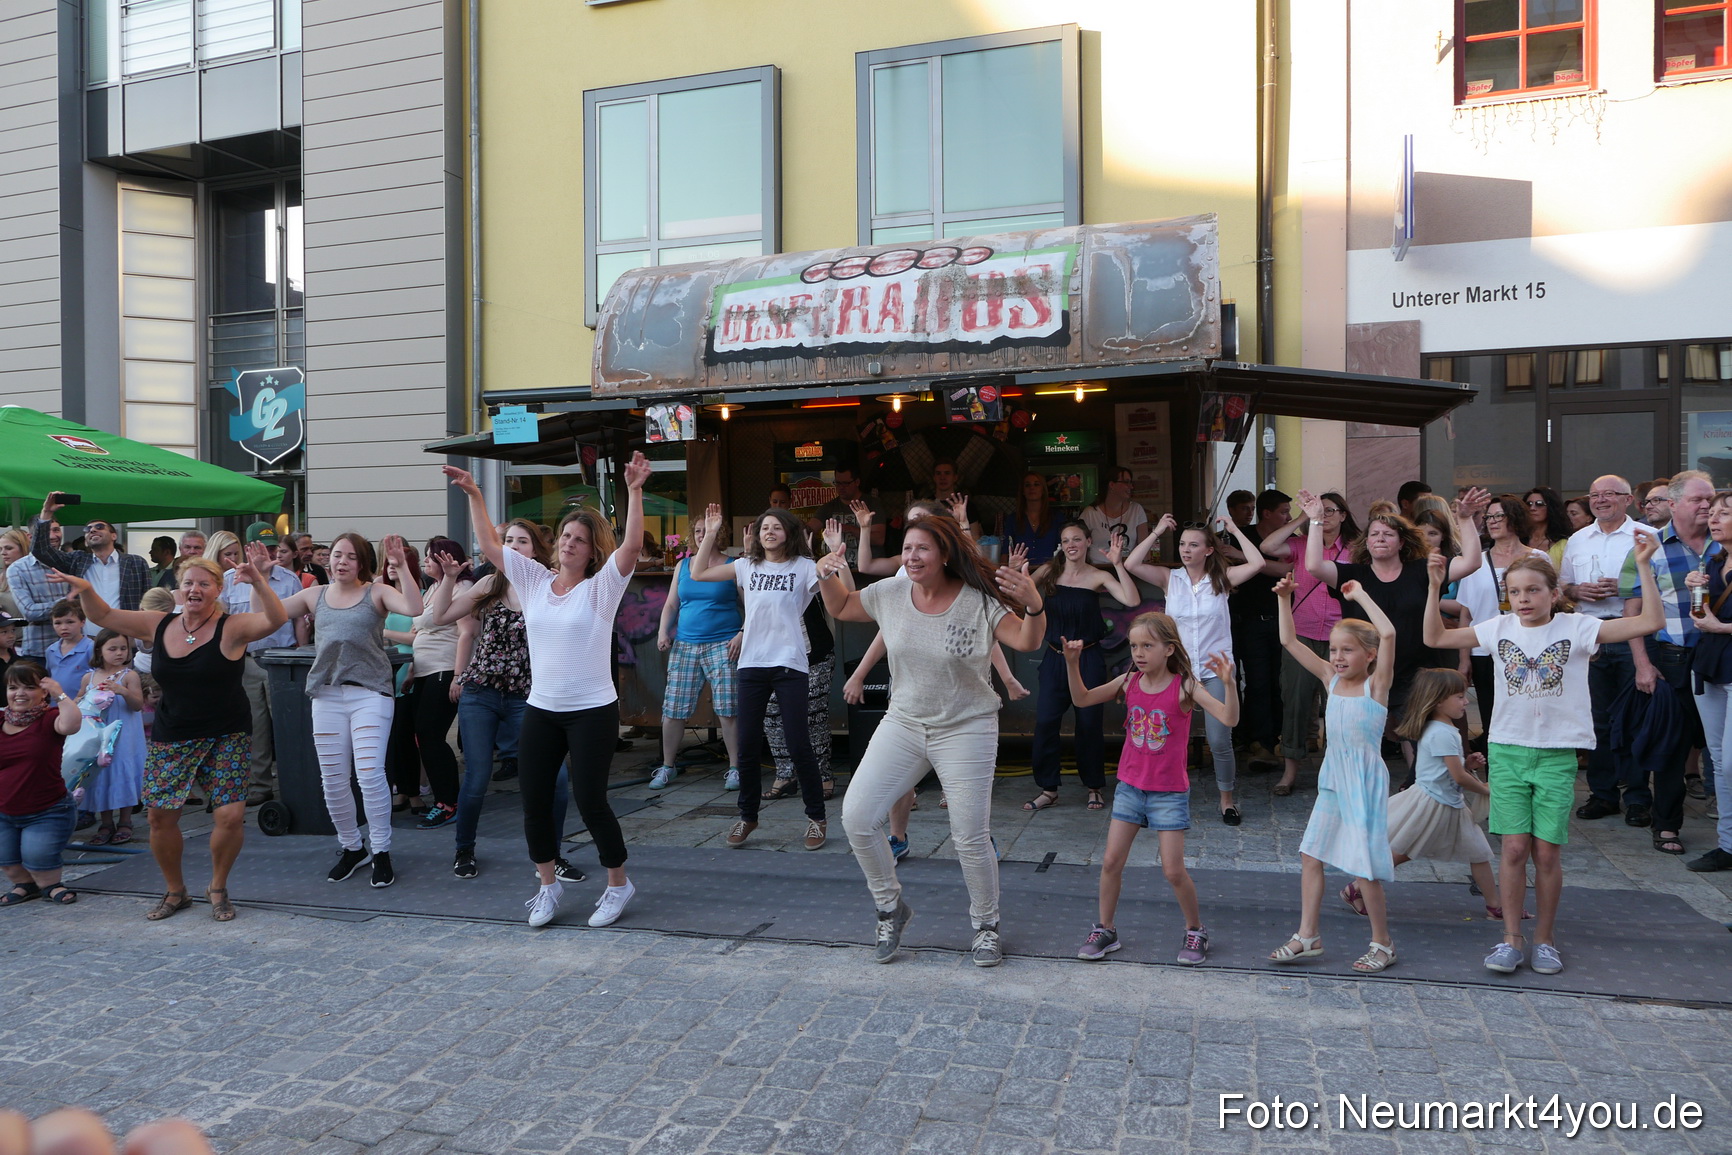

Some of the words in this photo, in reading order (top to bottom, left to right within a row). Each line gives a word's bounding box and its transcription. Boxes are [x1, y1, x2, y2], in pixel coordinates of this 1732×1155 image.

[1392, 290, 1460, 309] Unterer
[1466, 285, 1518, 304] Markt
[1525, 282, 1546, 299] 15
[252, 387, 287, 441] G2
[1045, 445, 1080, 453] Heineken
[52, 458, 193, 478] Lammsbräu
[59, 453, 159, 468] Neumarkter
[790, 487, 837, 509] ESPERADOS
[750, 571, 797, 592] STREET
